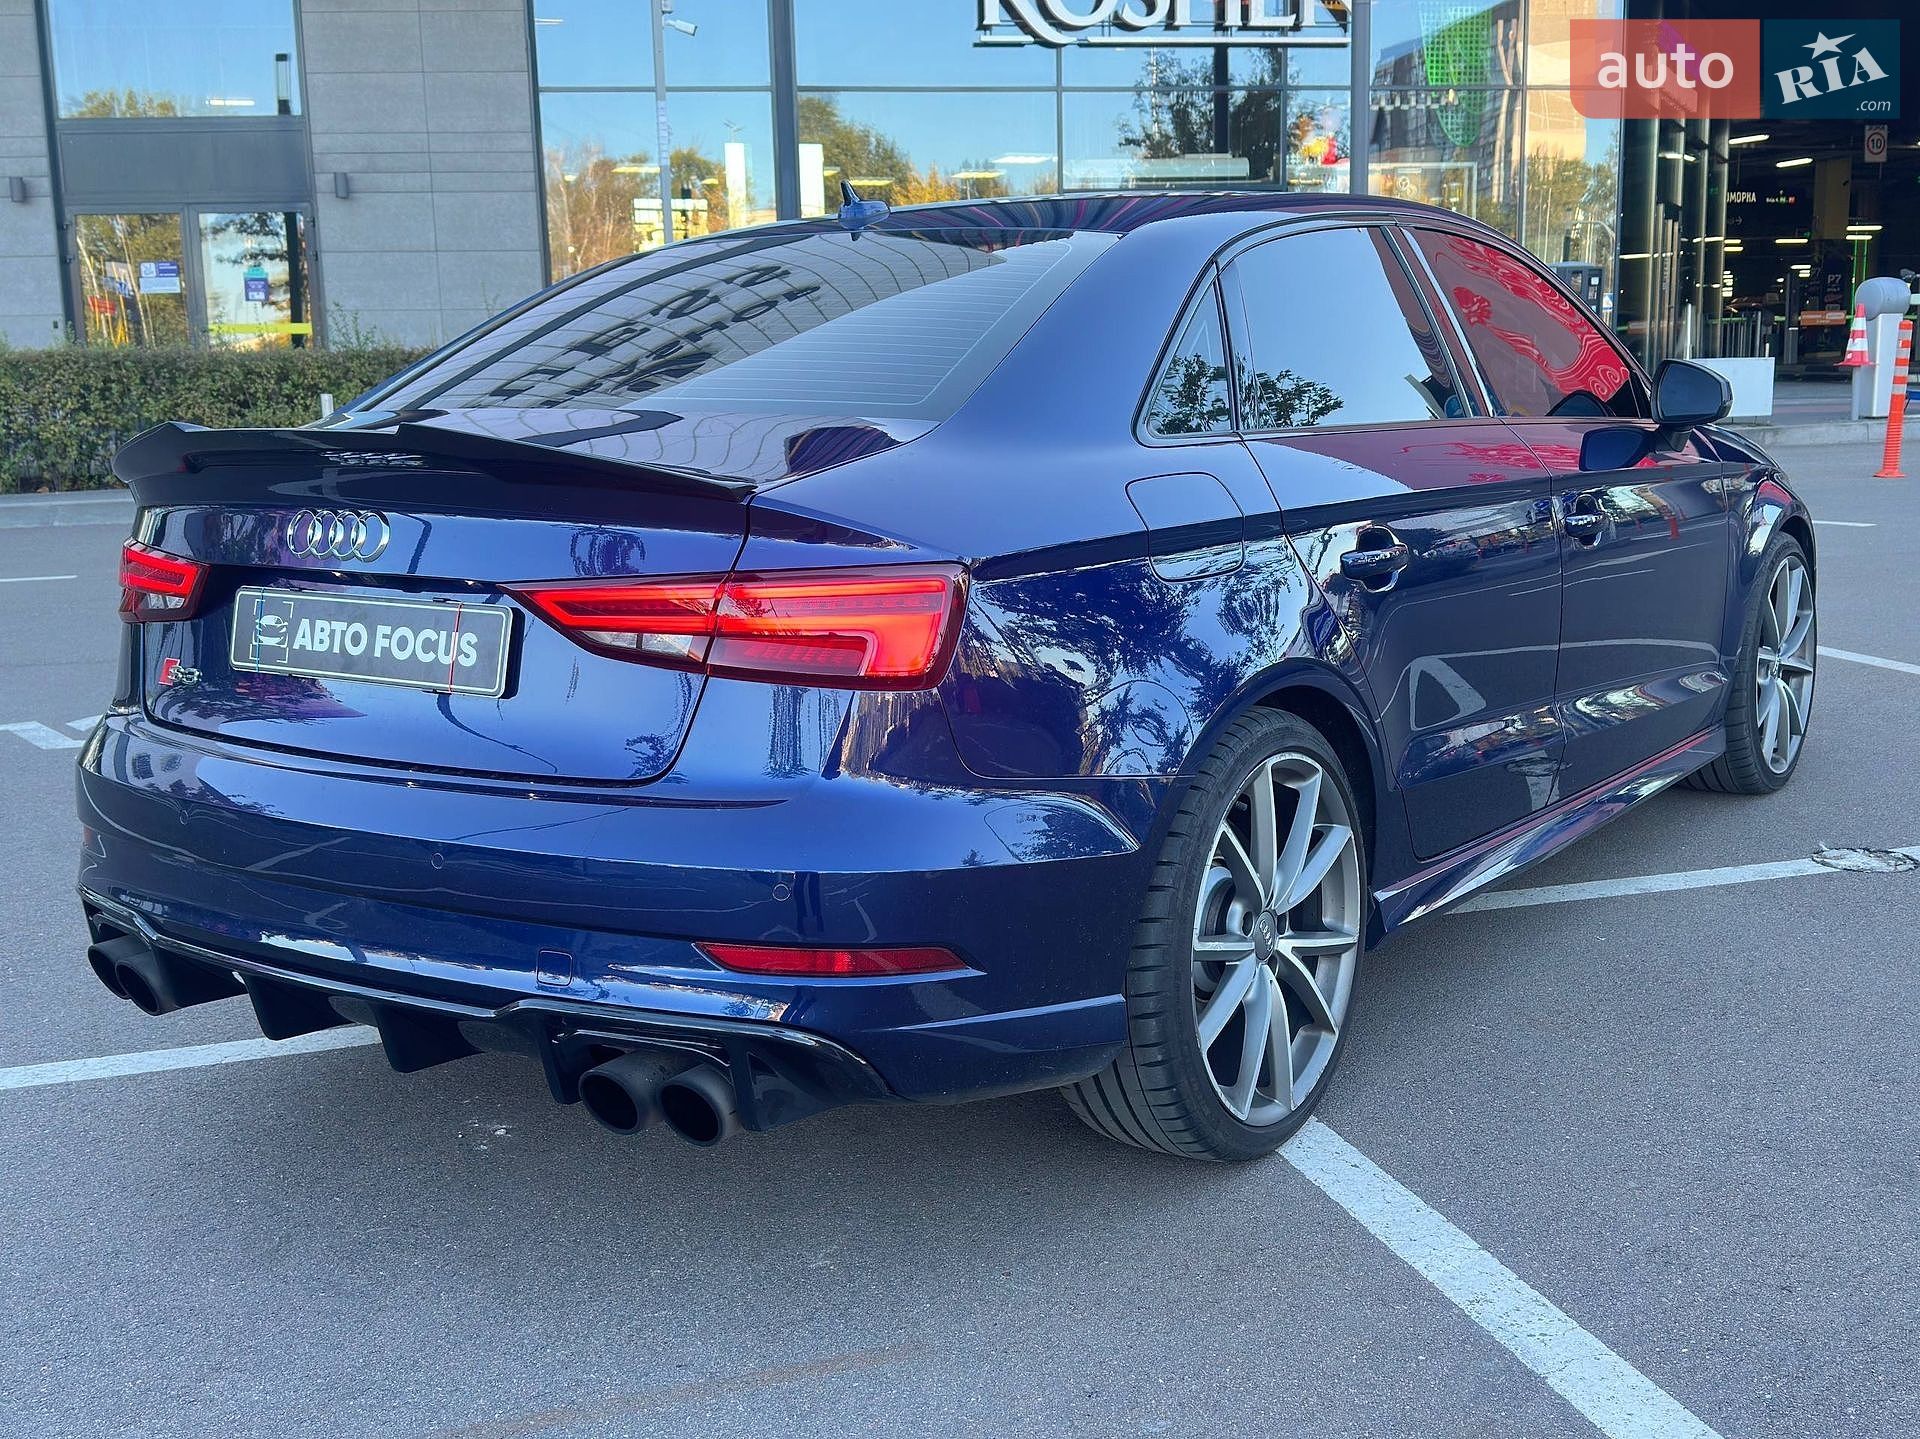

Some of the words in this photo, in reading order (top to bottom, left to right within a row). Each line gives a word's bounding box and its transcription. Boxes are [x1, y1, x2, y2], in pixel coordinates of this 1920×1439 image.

[1871, 138, 1882, 149] 10
[293, 618, 368, 656] АВТО
[374, 624, 478, 667] FOCUS
